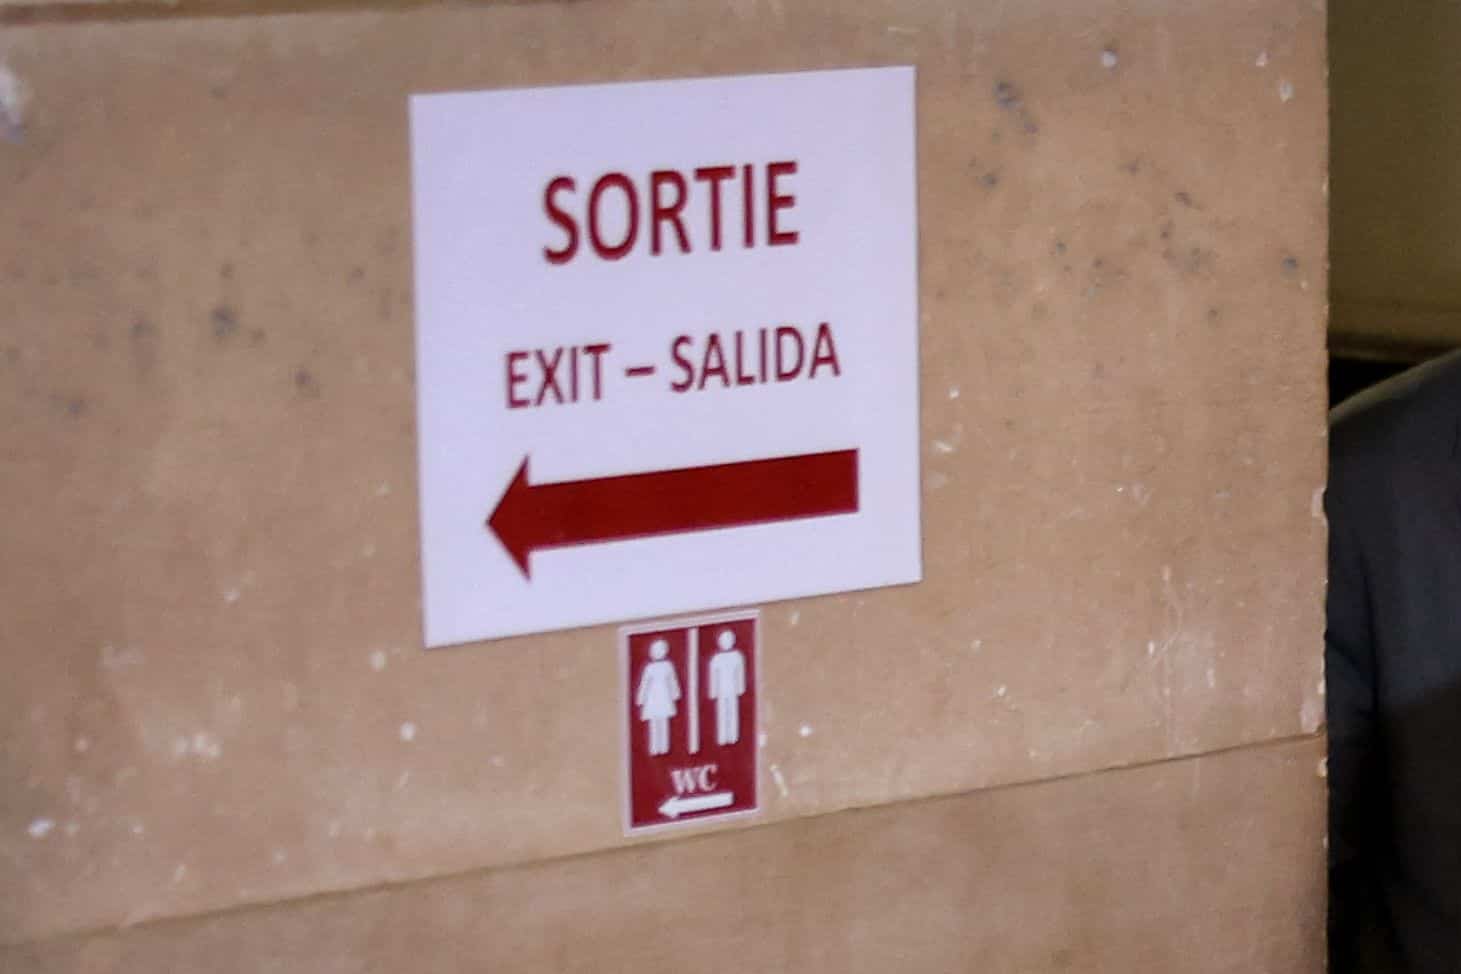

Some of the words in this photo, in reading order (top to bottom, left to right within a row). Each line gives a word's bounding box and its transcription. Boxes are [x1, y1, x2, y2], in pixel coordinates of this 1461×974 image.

[543, 161, 799, 265] SORTIE
[506, 342, 611, 409] EXIT
[670, 322, 840, 393] SALIDA
[670, 764, 718, 794] WC
